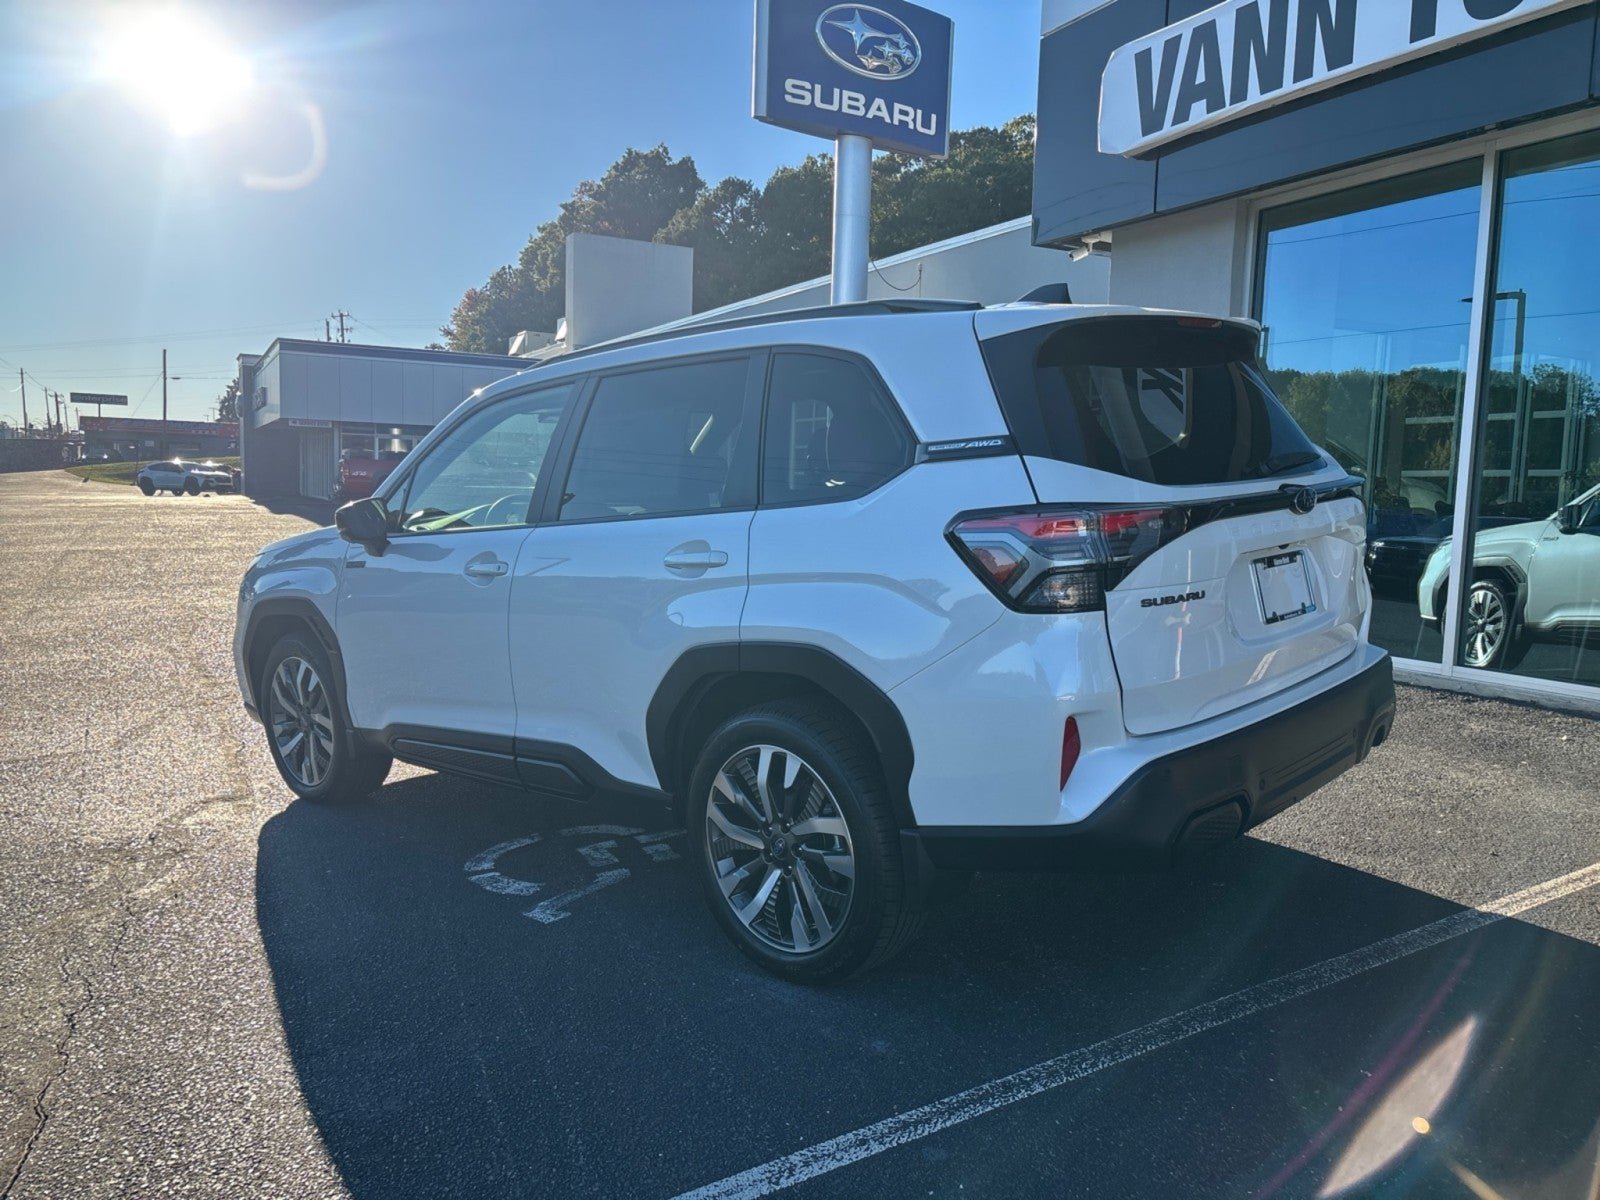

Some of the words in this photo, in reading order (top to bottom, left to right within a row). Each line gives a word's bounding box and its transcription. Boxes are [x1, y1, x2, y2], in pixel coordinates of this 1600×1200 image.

[1134, 0, 1357, 137] VANN
[784, 78, 937, 136] SUBARU
[1140, 590, 1206, 608] SUBARU
